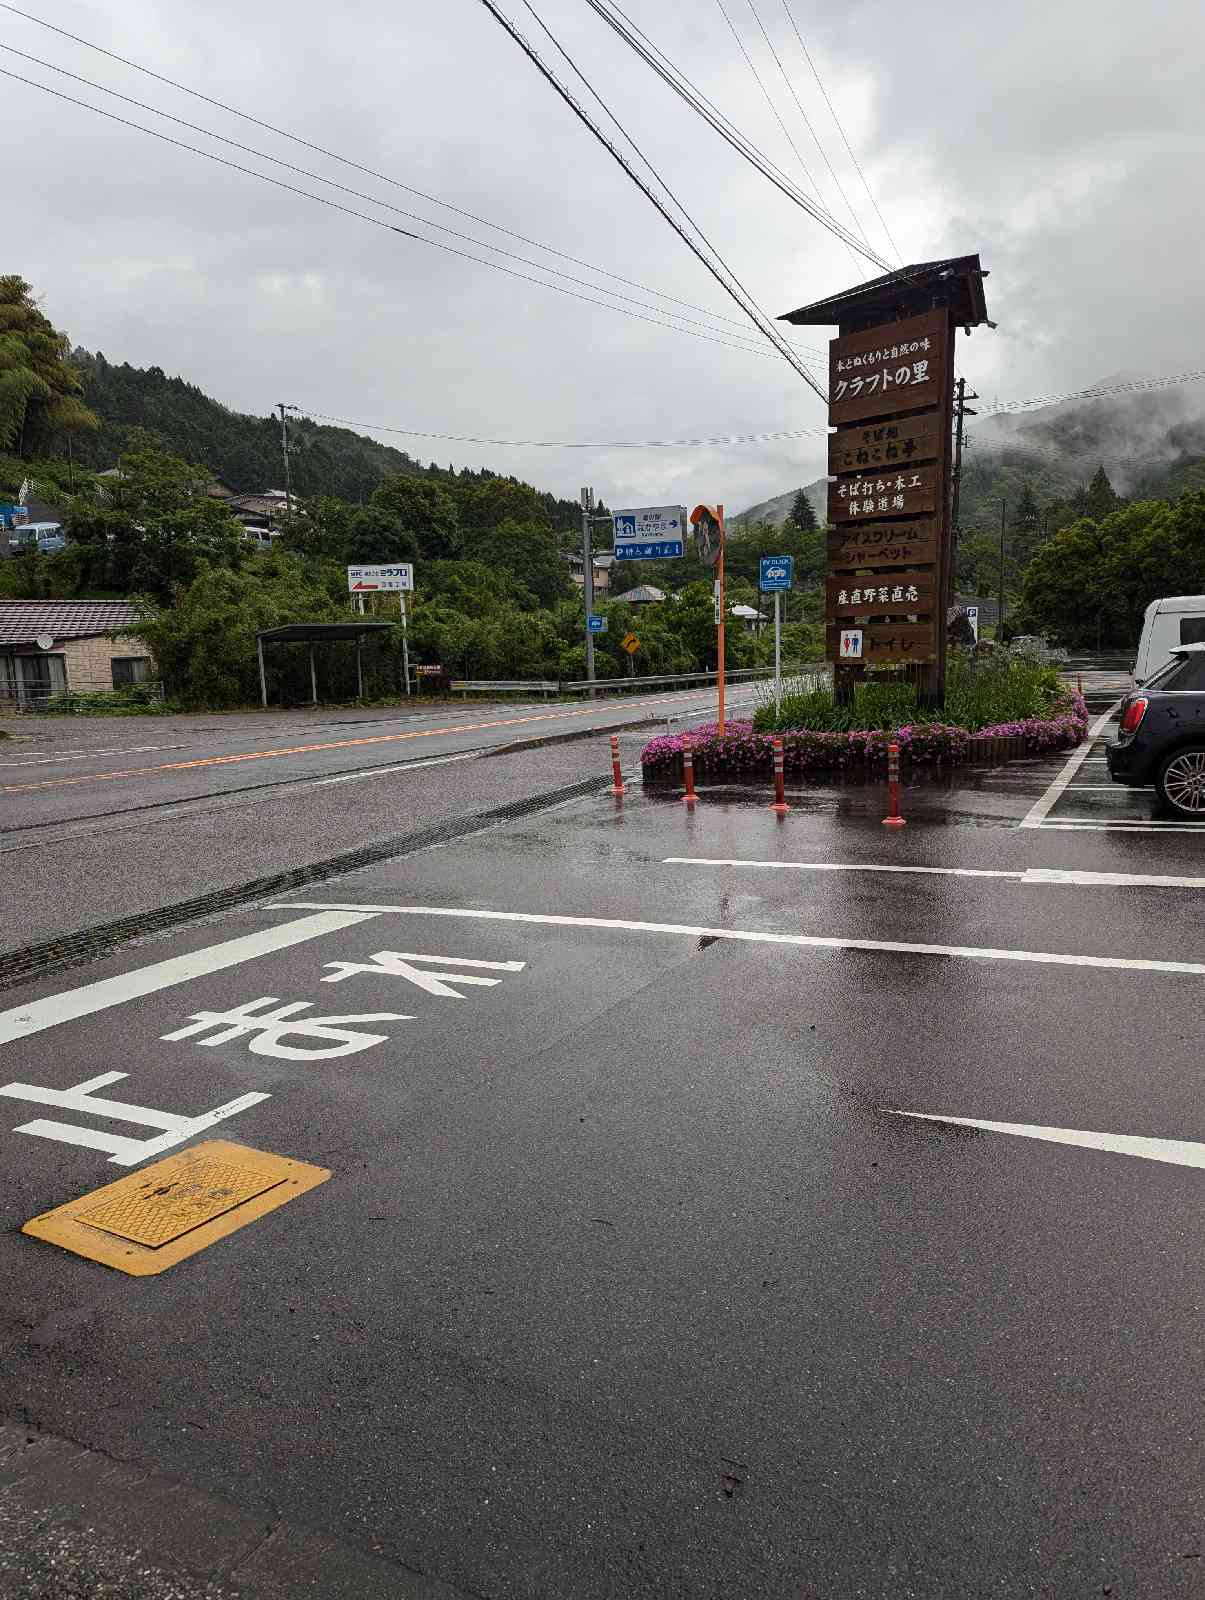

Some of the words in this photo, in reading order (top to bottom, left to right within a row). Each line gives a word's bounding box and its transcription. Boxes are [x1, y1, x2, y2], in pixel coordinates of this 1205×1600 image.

[834, 360, 930, 401] クラフトの里
[849, 495, 904, 516] 体験道場
[841, 528, 918, 546] アイスクリーム
[847, 547, 913, 563] シャーベット
[837, 585, 919, 606] 産直野菜直売
[870, 636, 915, 652] トイレ
